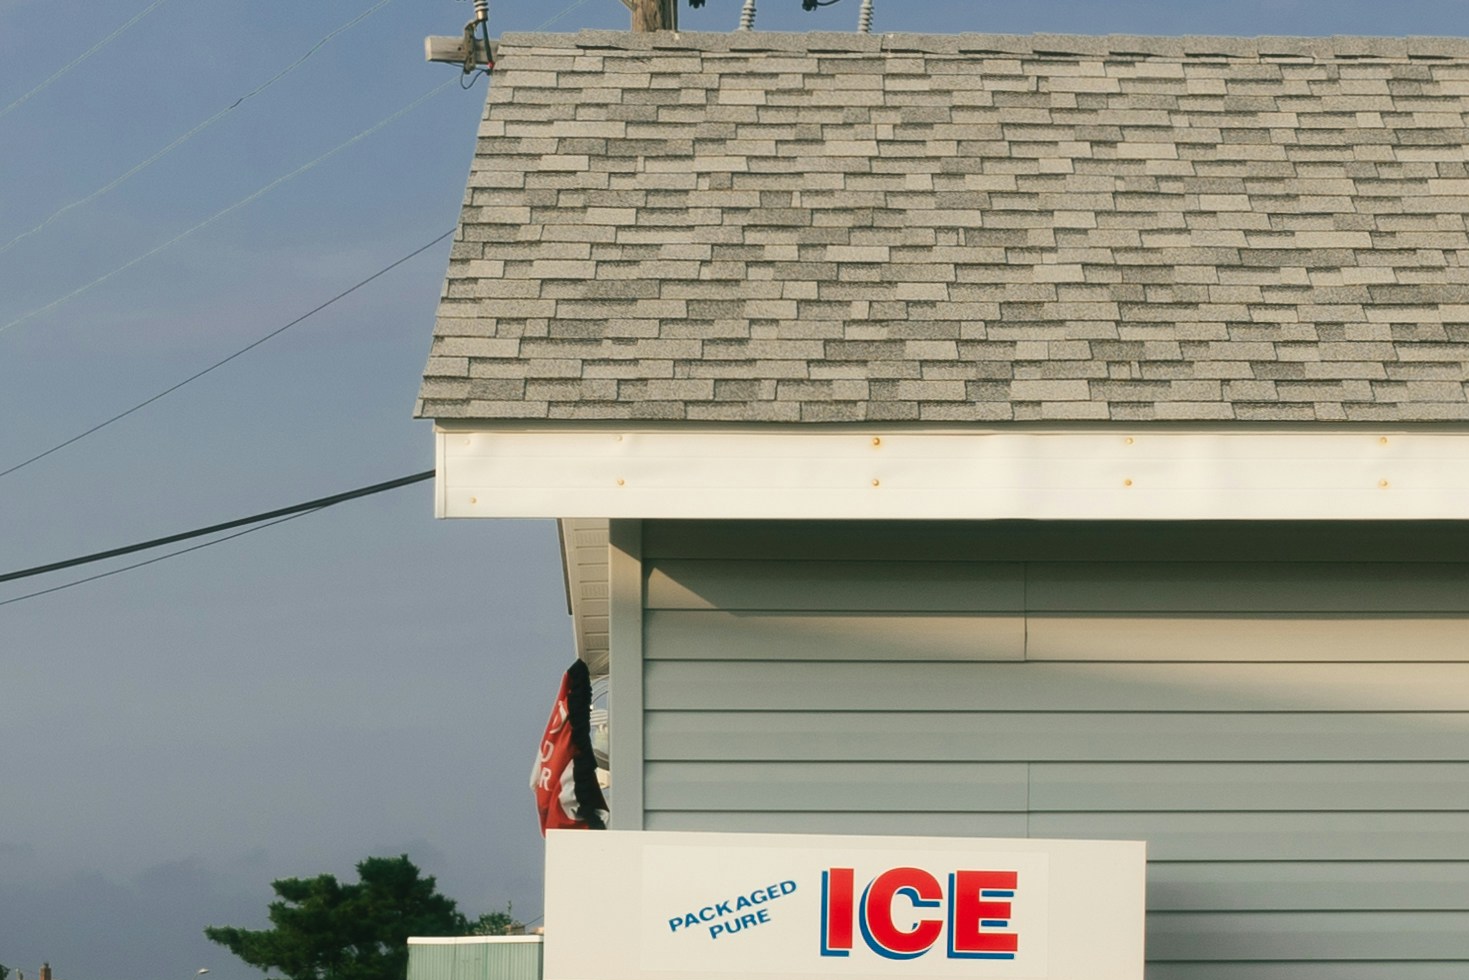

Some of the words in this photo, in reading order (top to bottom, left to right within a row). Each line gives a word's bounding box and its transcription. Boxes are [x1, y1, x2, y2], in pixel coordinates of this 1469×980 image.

[668, 880, 798, 932] PACKAGED
[708, 908, 772, 940] PURE
[820, 867, 1019, 960] ICE
